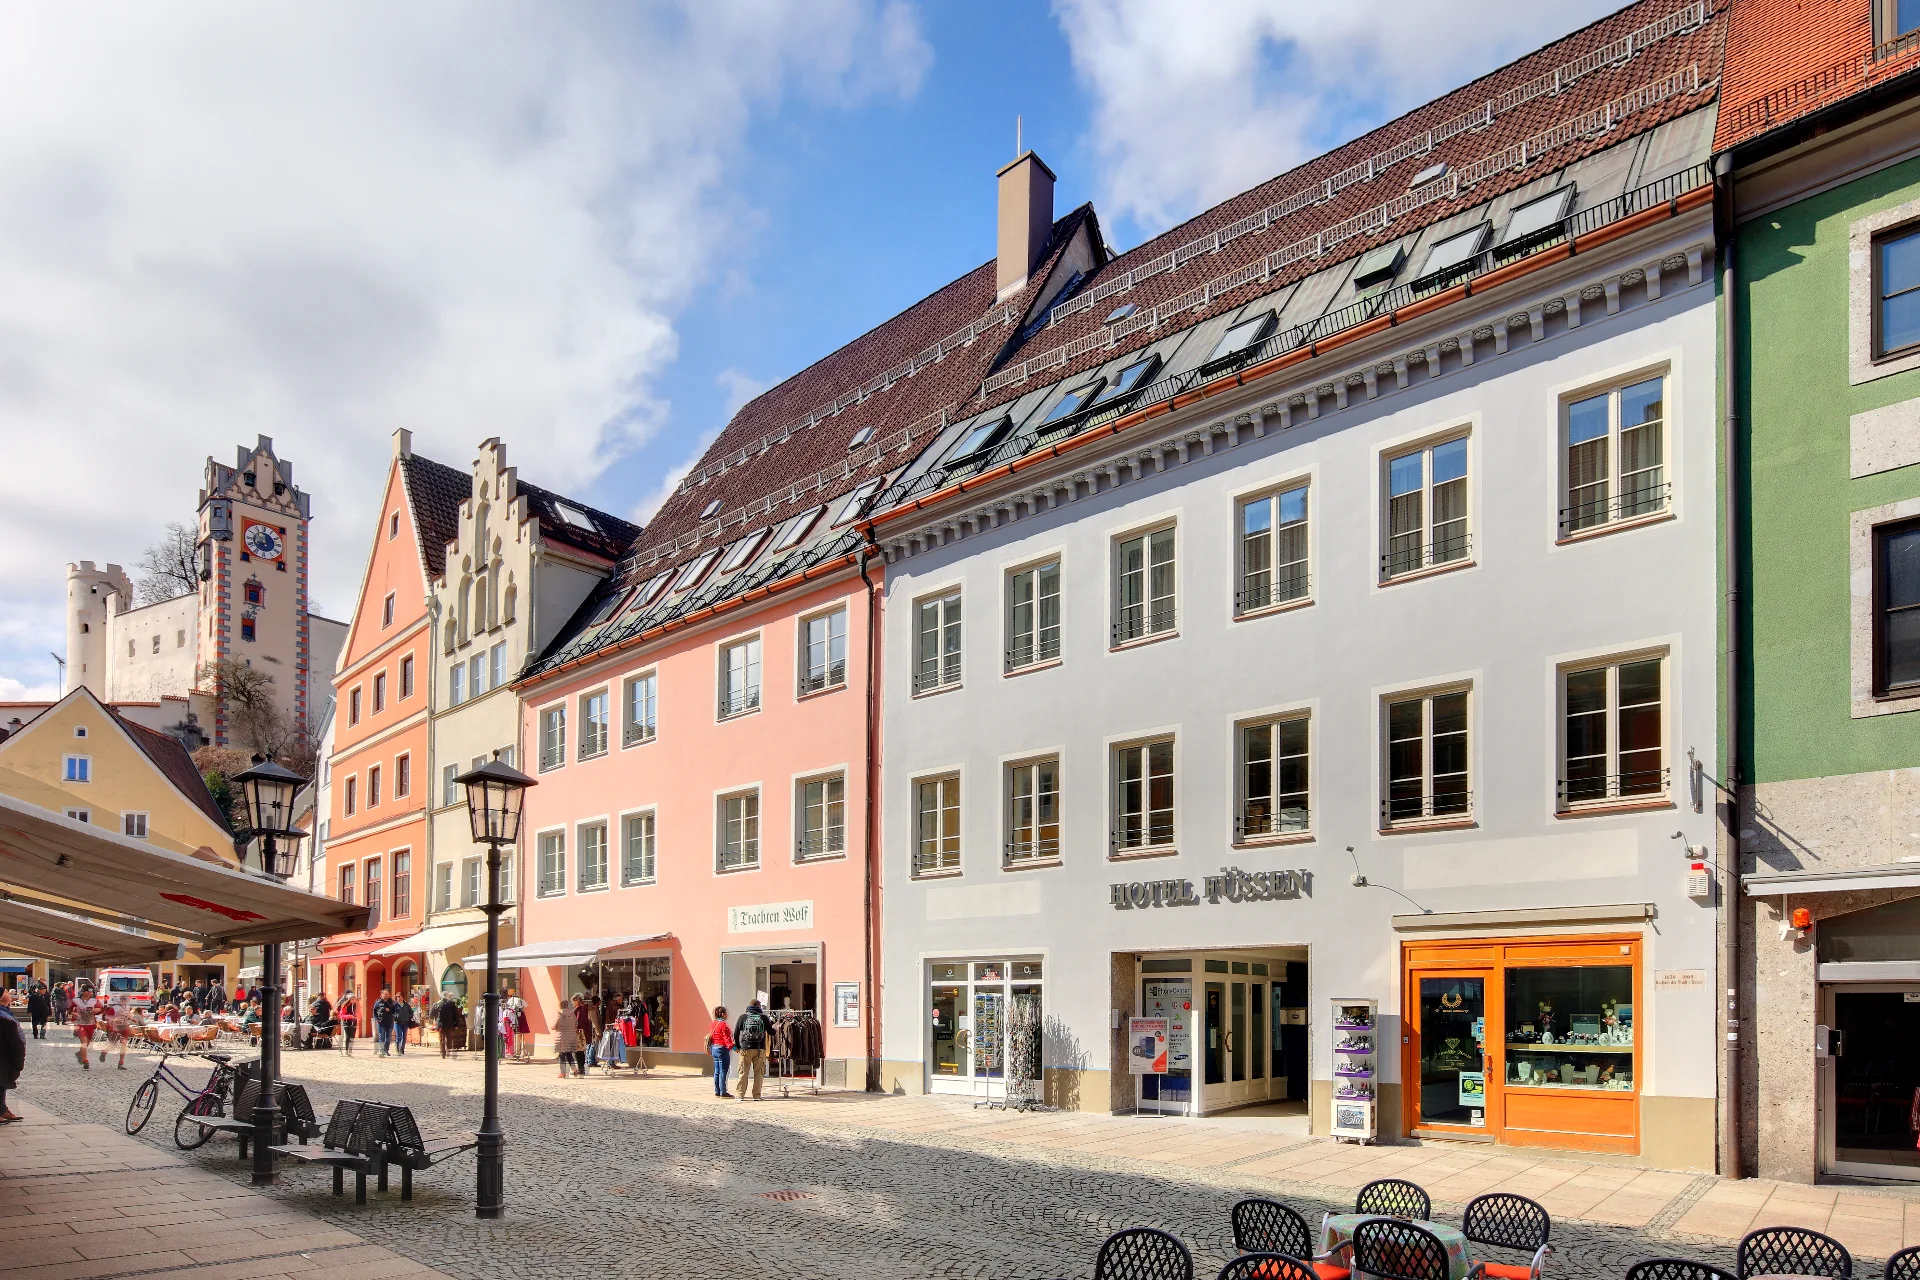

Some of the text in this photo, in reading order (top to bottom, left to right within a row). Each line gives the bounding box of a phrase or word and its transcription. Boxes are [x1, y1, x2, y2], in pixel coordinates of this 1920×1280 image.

[1109, 866, 1308, 905] HOTEL FÜSSEN
[740, 905, 809, 926] Trachten Wolf
